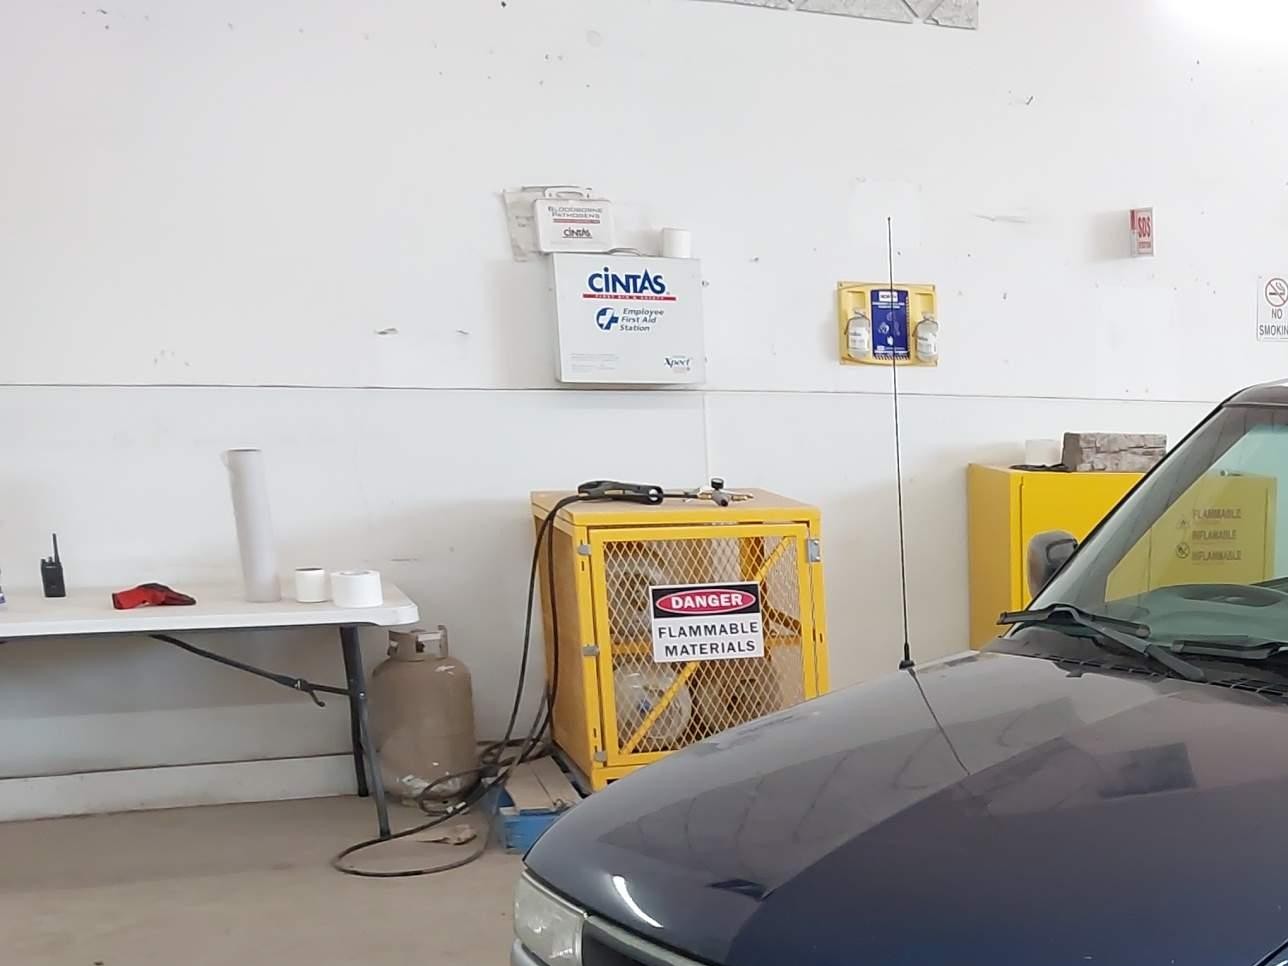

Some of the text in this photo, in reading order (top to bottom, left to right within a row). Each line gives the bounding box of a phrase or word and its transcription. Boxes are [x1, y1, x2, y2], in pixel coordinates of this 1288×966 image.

[623, 308, 664, 317] Employee
[1271, 308, 1283, 319] NO
[671, 593, 742, 609] DANGER
[658, 622, 759, 638] FLAMMABLE
[664, 641, 755, 657] MATERIALS
